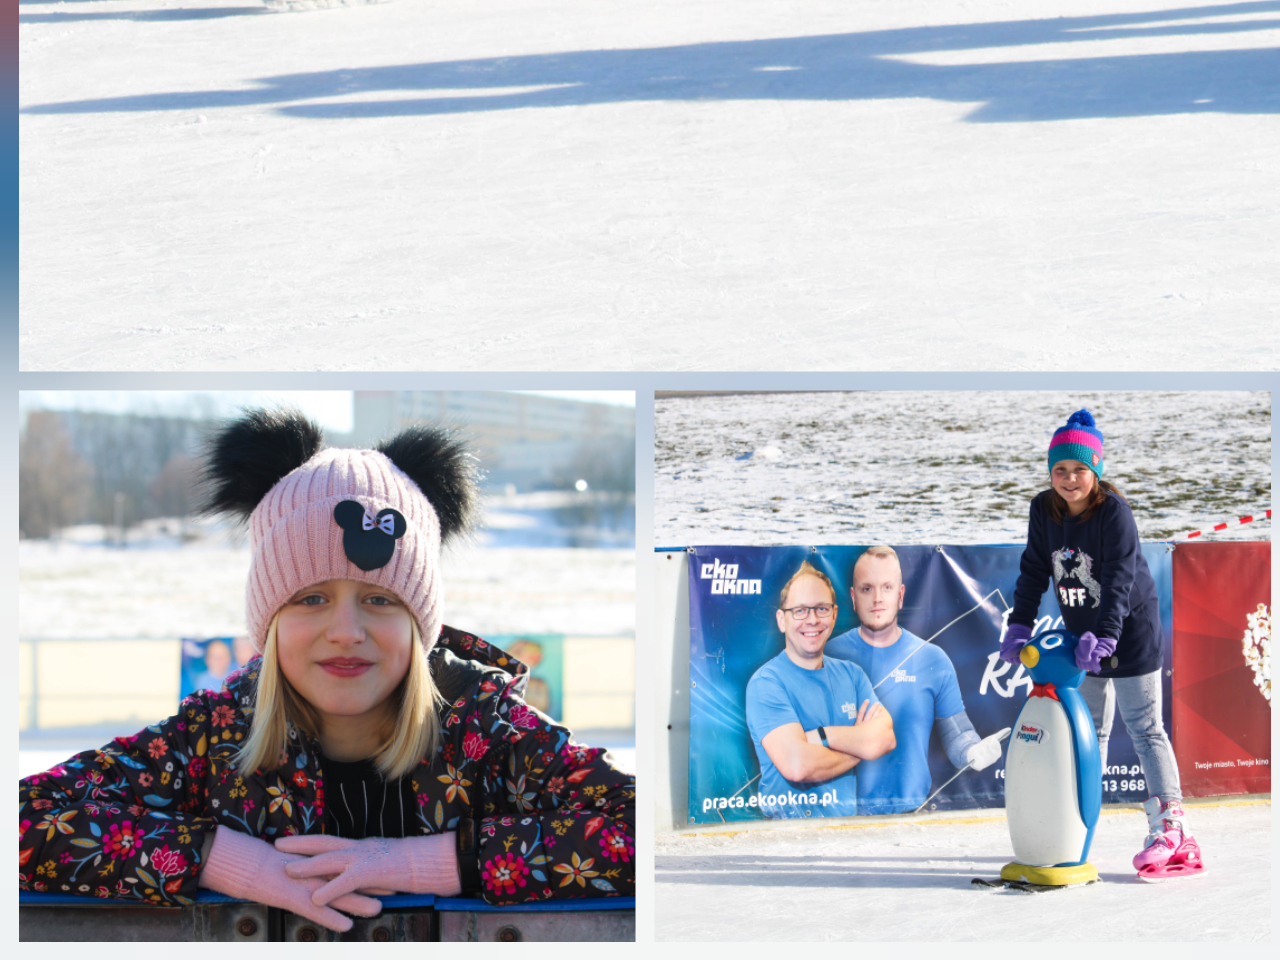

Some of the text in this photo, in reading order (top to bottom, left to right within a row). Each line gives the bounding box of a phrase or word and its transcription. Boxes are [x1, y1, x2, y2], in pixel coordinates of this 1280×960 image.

[701, 557, 739, 579] eko
[1058, 586, 1087, 607] BFF
[1194, 761, 1212, 770] Twoje
[1237, 758, 1254, 767] Twoje
[1256, 758, 1269, 766] kino
[1120, 779, 1146, 792] 968
[703, 789, 839, 813] praca.ekookna.pl
